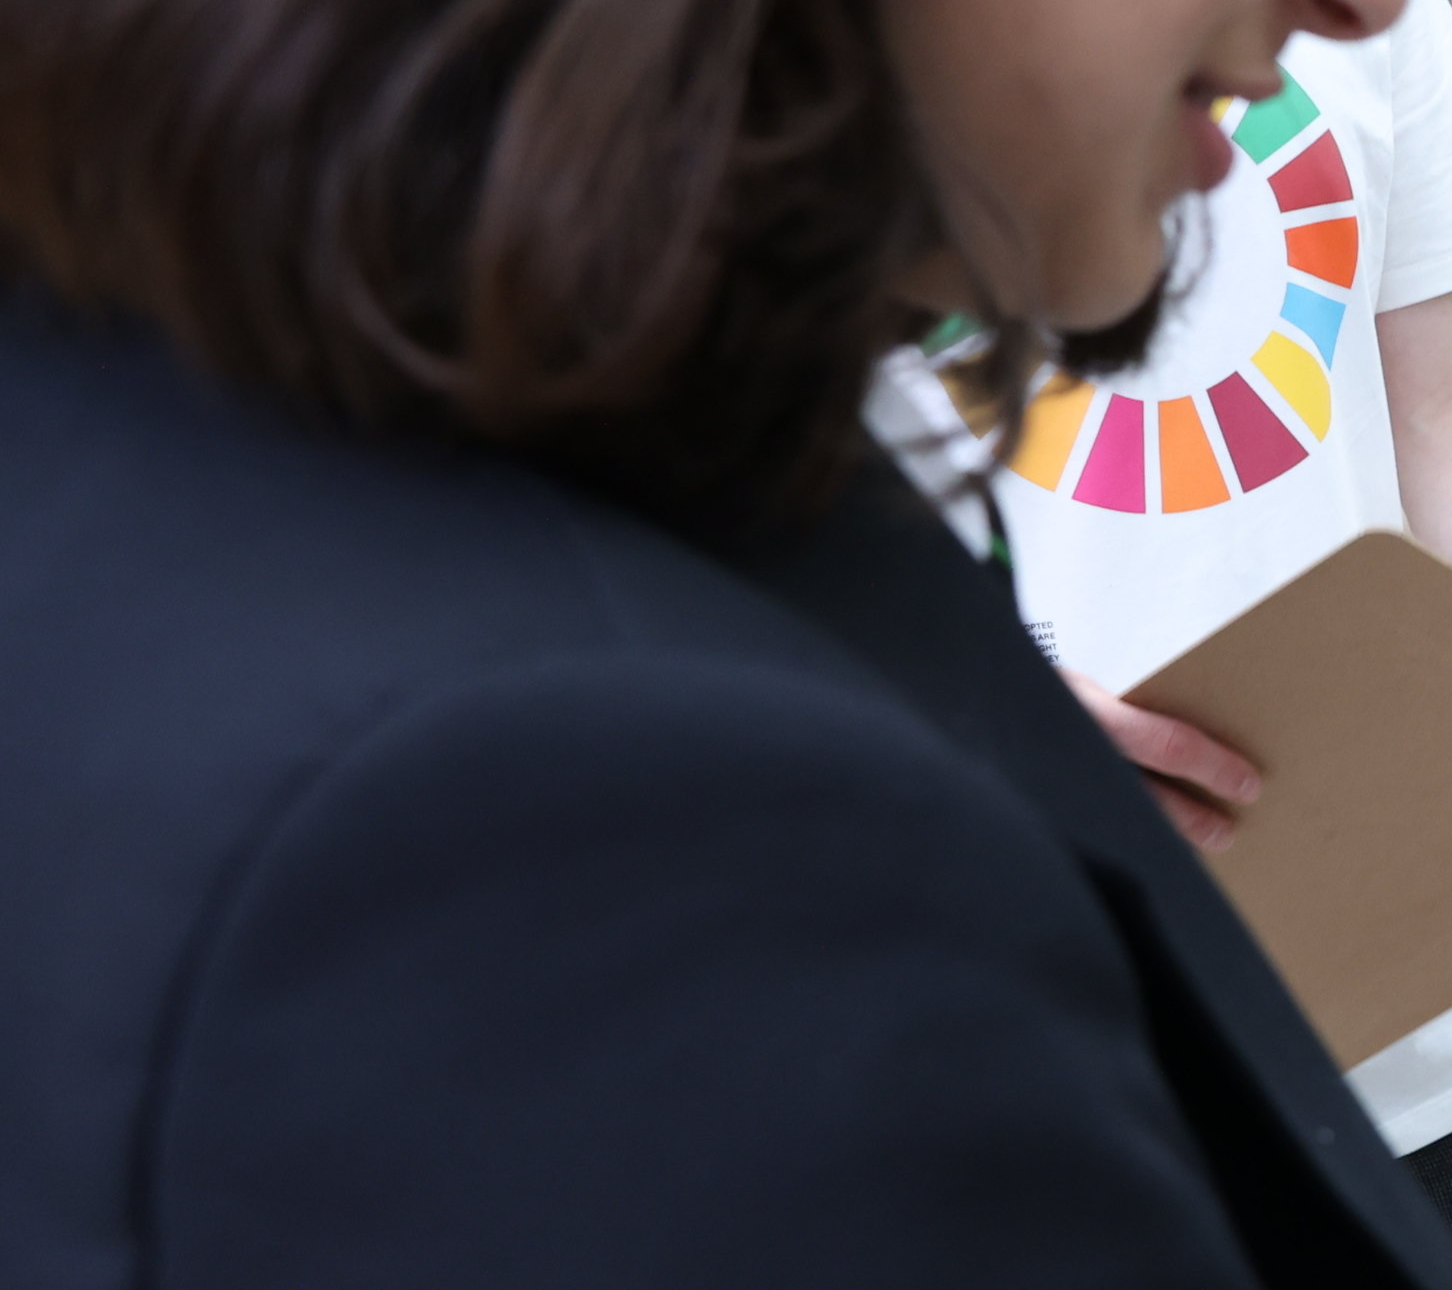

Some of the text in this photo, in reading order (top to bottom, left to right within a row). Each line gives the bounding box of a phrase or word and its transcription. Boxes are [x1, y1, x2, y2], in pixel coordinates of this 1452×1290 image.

[1024, 620, 1054, 631] OPTED
[1037, 632, 1056, 641] ARE
[1039, 643, 1057, 652] GHT
